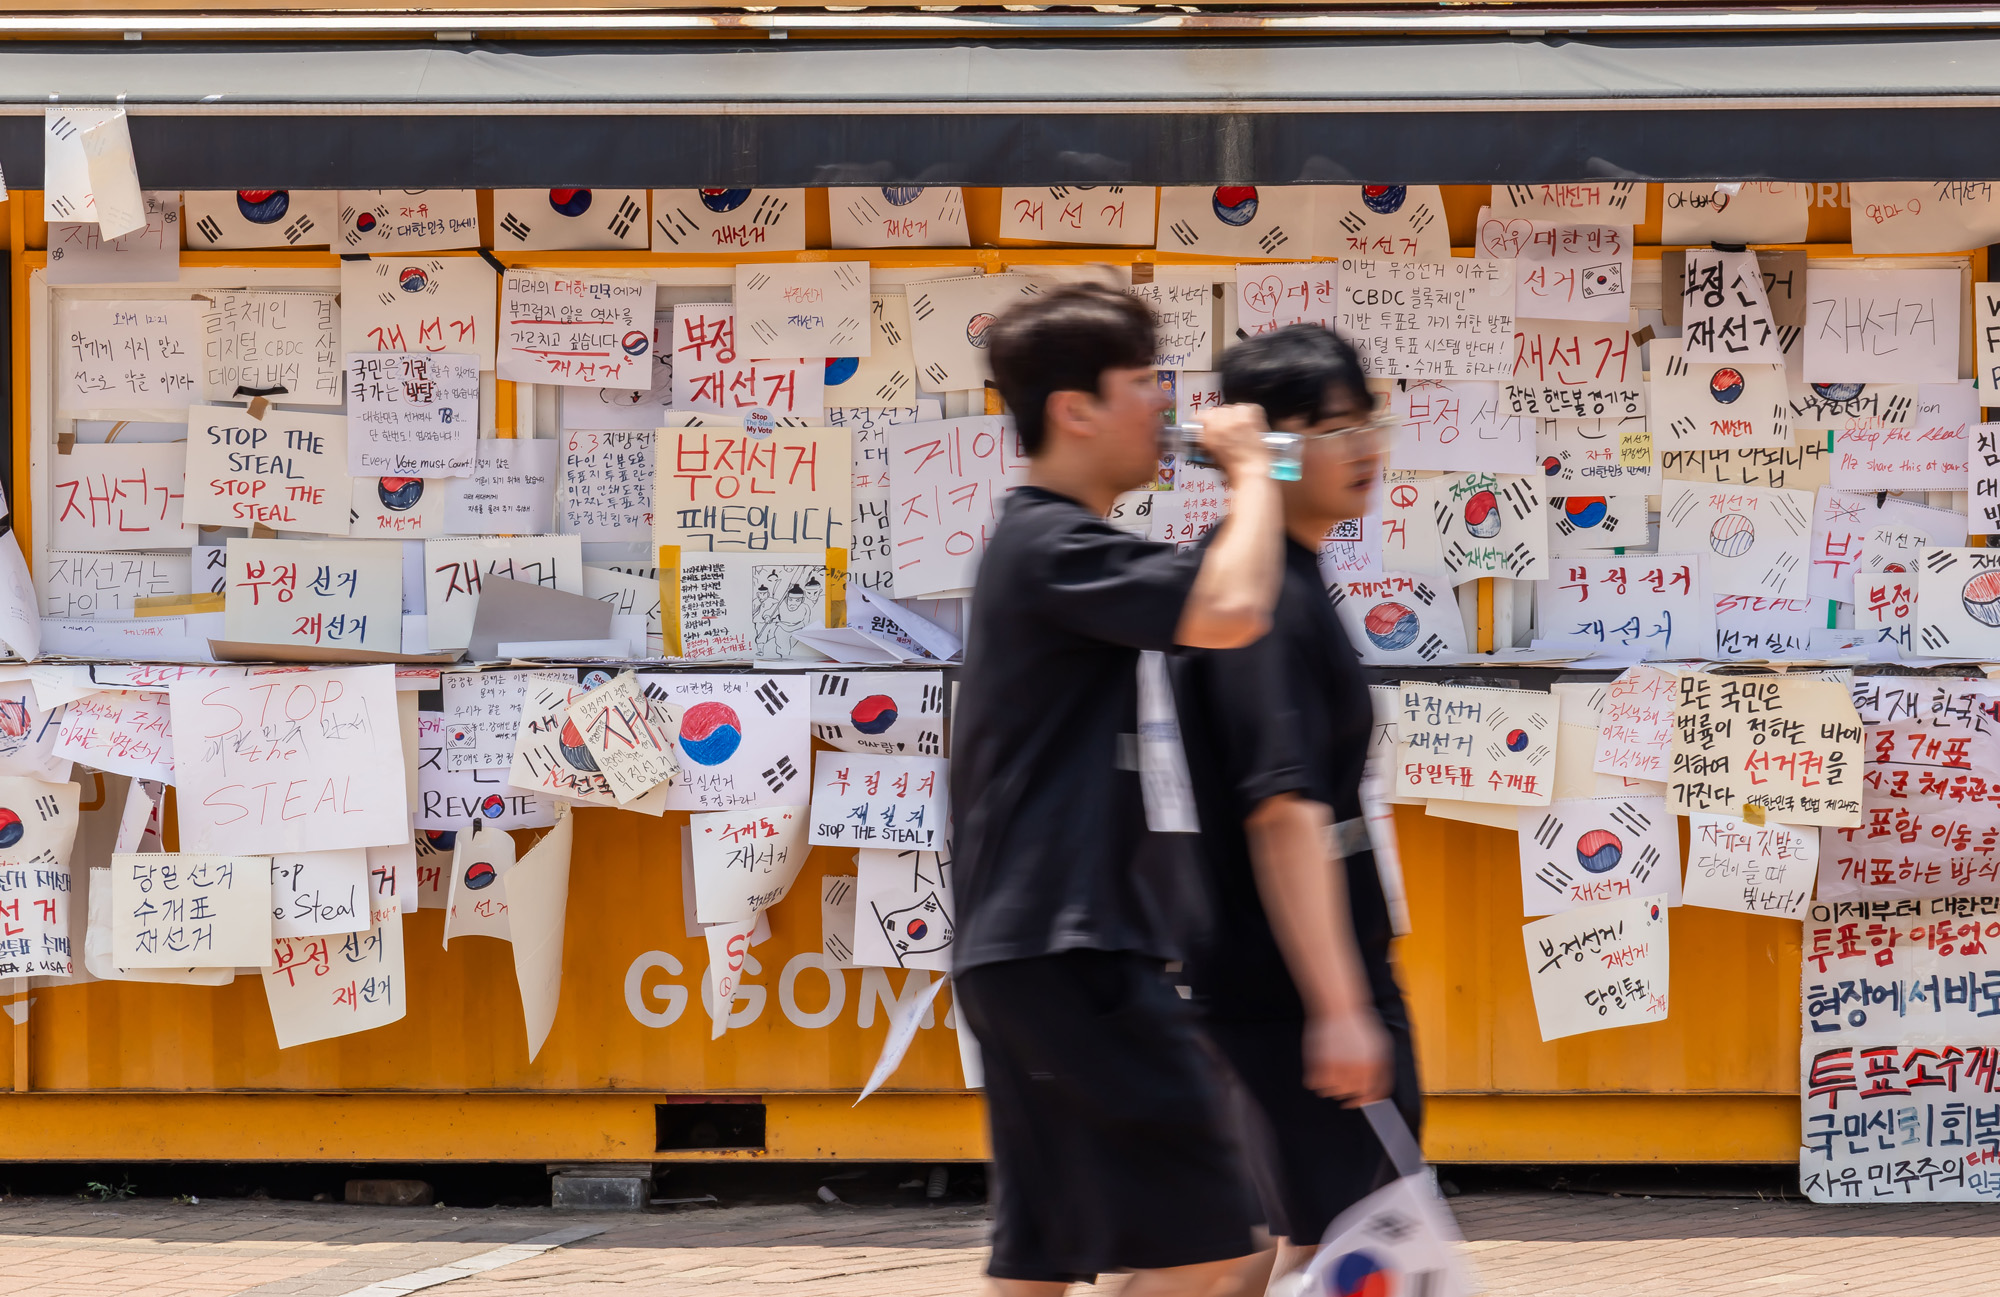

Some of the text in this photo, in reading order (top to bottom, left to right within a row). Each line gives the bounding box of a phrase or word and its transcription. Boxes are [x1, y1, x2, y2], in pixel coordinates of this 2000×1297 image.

[400, 204, 428, 218] 자유
[397, 218, 444, 237] 대한민국
[712, 225, 765, 247] 재선거
[883, 218, 928, 239] 재선거
[1346, 236, 1418, 257] 재선거
[1342, 259, 1376, 279] 이번
[508, 279, 549, 295] 미래의
[509, 301, 556, 322] 부끄럽지
[1342, 312, 1372, 331] 기반
[1380, 311, 1420, 331] 투표로
[1427, 314, 1451, 330] 가기
[1812, 297, 1936, 356] 재선거
[124, 337, 150, 361] 지지
[158, 336, 185, 358] 말고
[264, 340, 304, 357] CBDC
[514, 331, 618, 351] 가르치고 싶습니다
[1395, 336, 1419, 355] 투표
[352, 359, 399, 380] 국민은
[1514, 330, 1630, 386] 재선거
[160, 371, 195, 394] 이기라
[351, 382, 399, 402] 국가는
[690, 366, 795, 412] 재선거
[1505, 385, 1540, 414] 잠실
[751, 412, 768, 421] Stop
[1402, 394, 1460, 444] 부정
[207, 425, 326, 455] STOP THE
[568, 431, 599, 454] 6.3
[746, 427, 758, 435] My
[1621, 434, 1651, 446] 재선거
[228, 452, 305, 480] STEAL
[361, 454, 391, 471] Every
[395, 454, 417, 469] Vote
[420, 459, 446, 469] must
[567, 454, 597, 468] 타인
[1585, 448, 1614, 461] 자유
[1867, 458, 1894, 473] share
[1899, 459, 1921, 473] this
[1926, 459, 1938, 471] at
[673, 433, 817, 502] 부정선거
[210, 479, 326, 505] STOP THE
[1709, 494, 1758, 512] 재선거
[232, 502, 297, 522] STEAL
[377, 513, 422, 531] 재선거
[1874, 530, 1927, 548] 재선거
[236, 560, 297, 606] 부정
[1347, 577, 1414, 598] 재선거
[291, 613, 367, 645] 재선거
[1679, 676, 1783, 713] 모든 국민은
[201, 680, 344, 739] STOP
[1404, 693, 1483, 727] 부정선거
[1678, 713, 1863, 750] 법률이 정하는 바에
[240, 739, 298, 763] the
[1406, 731, 1474, 758] 재선거
[1907, 734, 1972, 770] 개표
[1405, 763, 1544, 798] 당일투표 수개표
[1673, 748, 1849, 788] 의하여 선거권을
[202, 775, 364, 826] STEAL
[1747, 795, 1796, 812] 대한민국
[1801, 796, 1822, 813] 헌법
[817, 823, 935, 848] STOP THE STEAL!
[1698, 821, 1810, 861] 자유의 깃발은
[1931, 820, 1972, 852] 이동
[726, 843, 789, 874] 재선거
[1698, 857, 1787, 885] 당신이 들 때
[1837, 856, 1942, 886] 개표하는
[132, 862, 234, 893] 당일 선거
[1571, 878, 1632, 903] 재선거
[133, 896, 217, 926] 수개표
[294, 884, 357, 923] Steal
[1812, 900, 1922, 924] 이제부터
[135, 924, 214, 956] 재선거
[1808, 921, 1904, 974] 투표함
[273, 927, 384, 988] 부정 선거
[332, 974, 392, 1012] 재선거
[1806, 974, 1943, 1034] 현장에서
